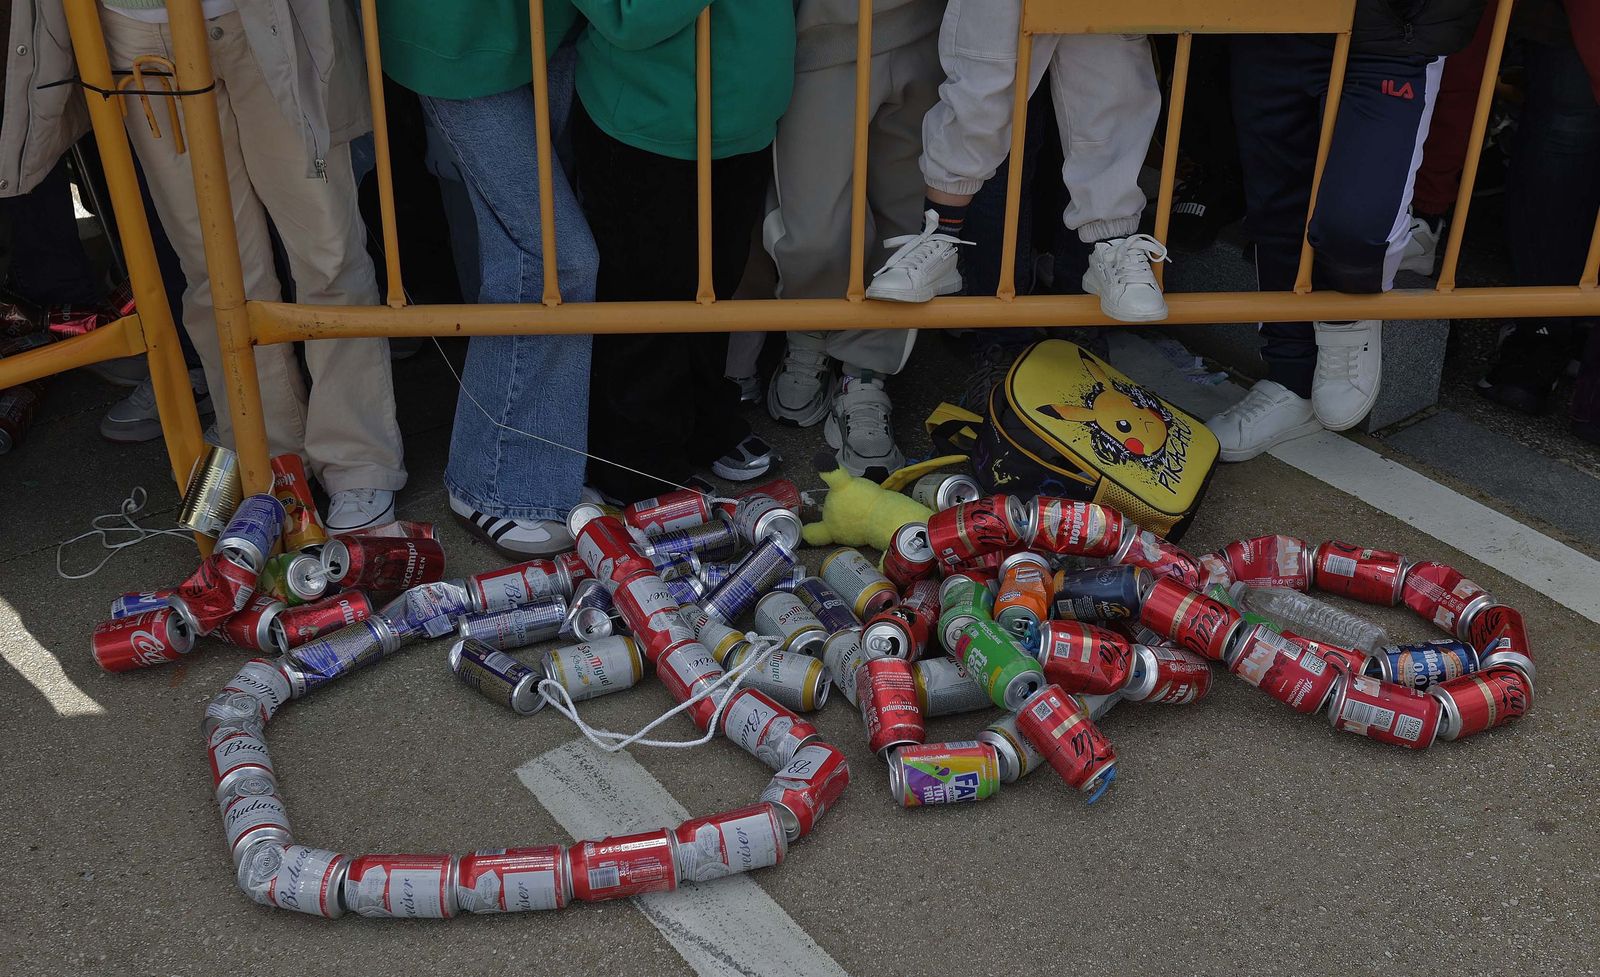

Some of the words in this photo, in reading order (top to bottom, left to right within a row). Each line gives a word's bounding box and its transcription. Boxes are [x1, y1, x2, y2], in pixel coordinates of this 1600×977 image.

[1382, 79, 1415, 99] ILA
[1158, 418, 1192, 494] PIKACHU
[1069, 501, 1085, 544] Mahou
[401, 542, 419, 590] uzcampo
[415, 556, 427, 585] ILSEN
[881, 704, 919, 714] Cruzcampo
